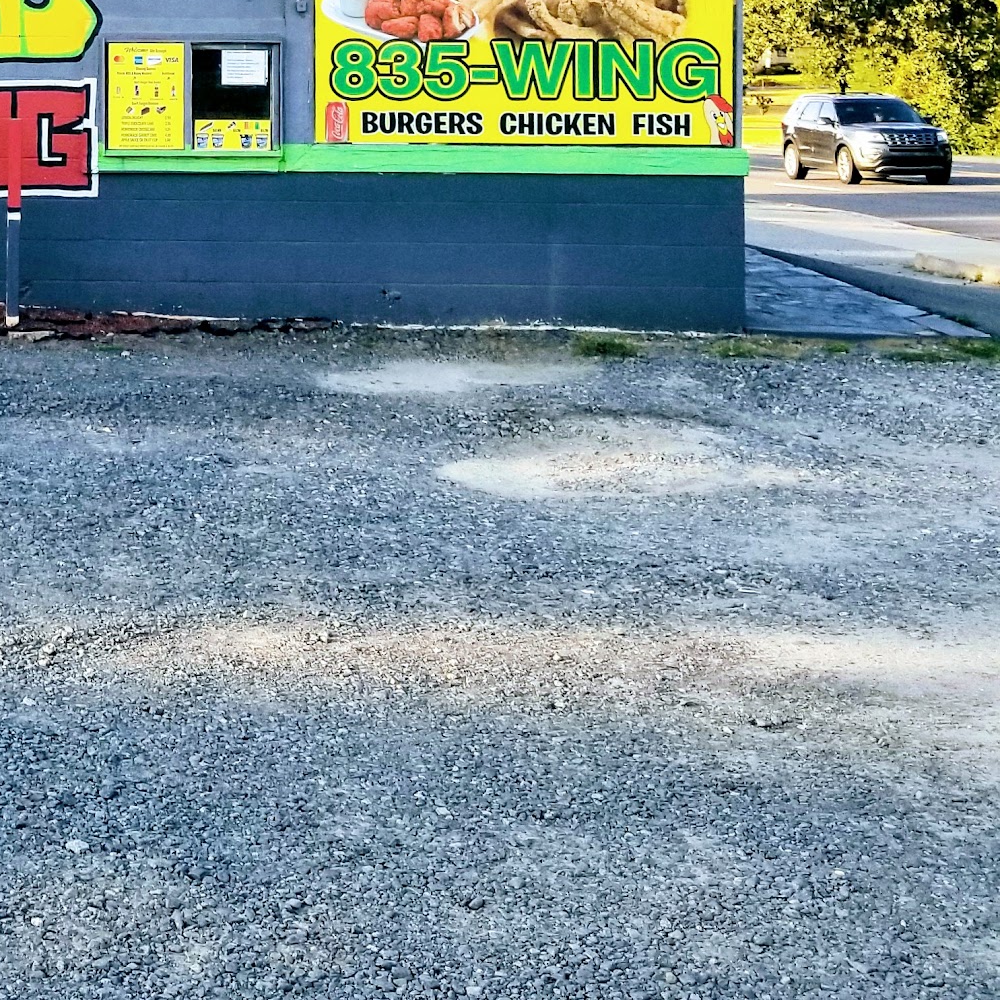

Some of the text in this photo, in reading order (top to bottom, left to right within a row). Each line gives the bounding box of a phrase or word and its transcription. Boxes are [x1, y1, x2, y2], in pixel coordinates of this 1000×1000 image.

[330, 38, 720, 102] 835-WING
[361, 110, 691, 136] BURGERS CHICKEN FISH
